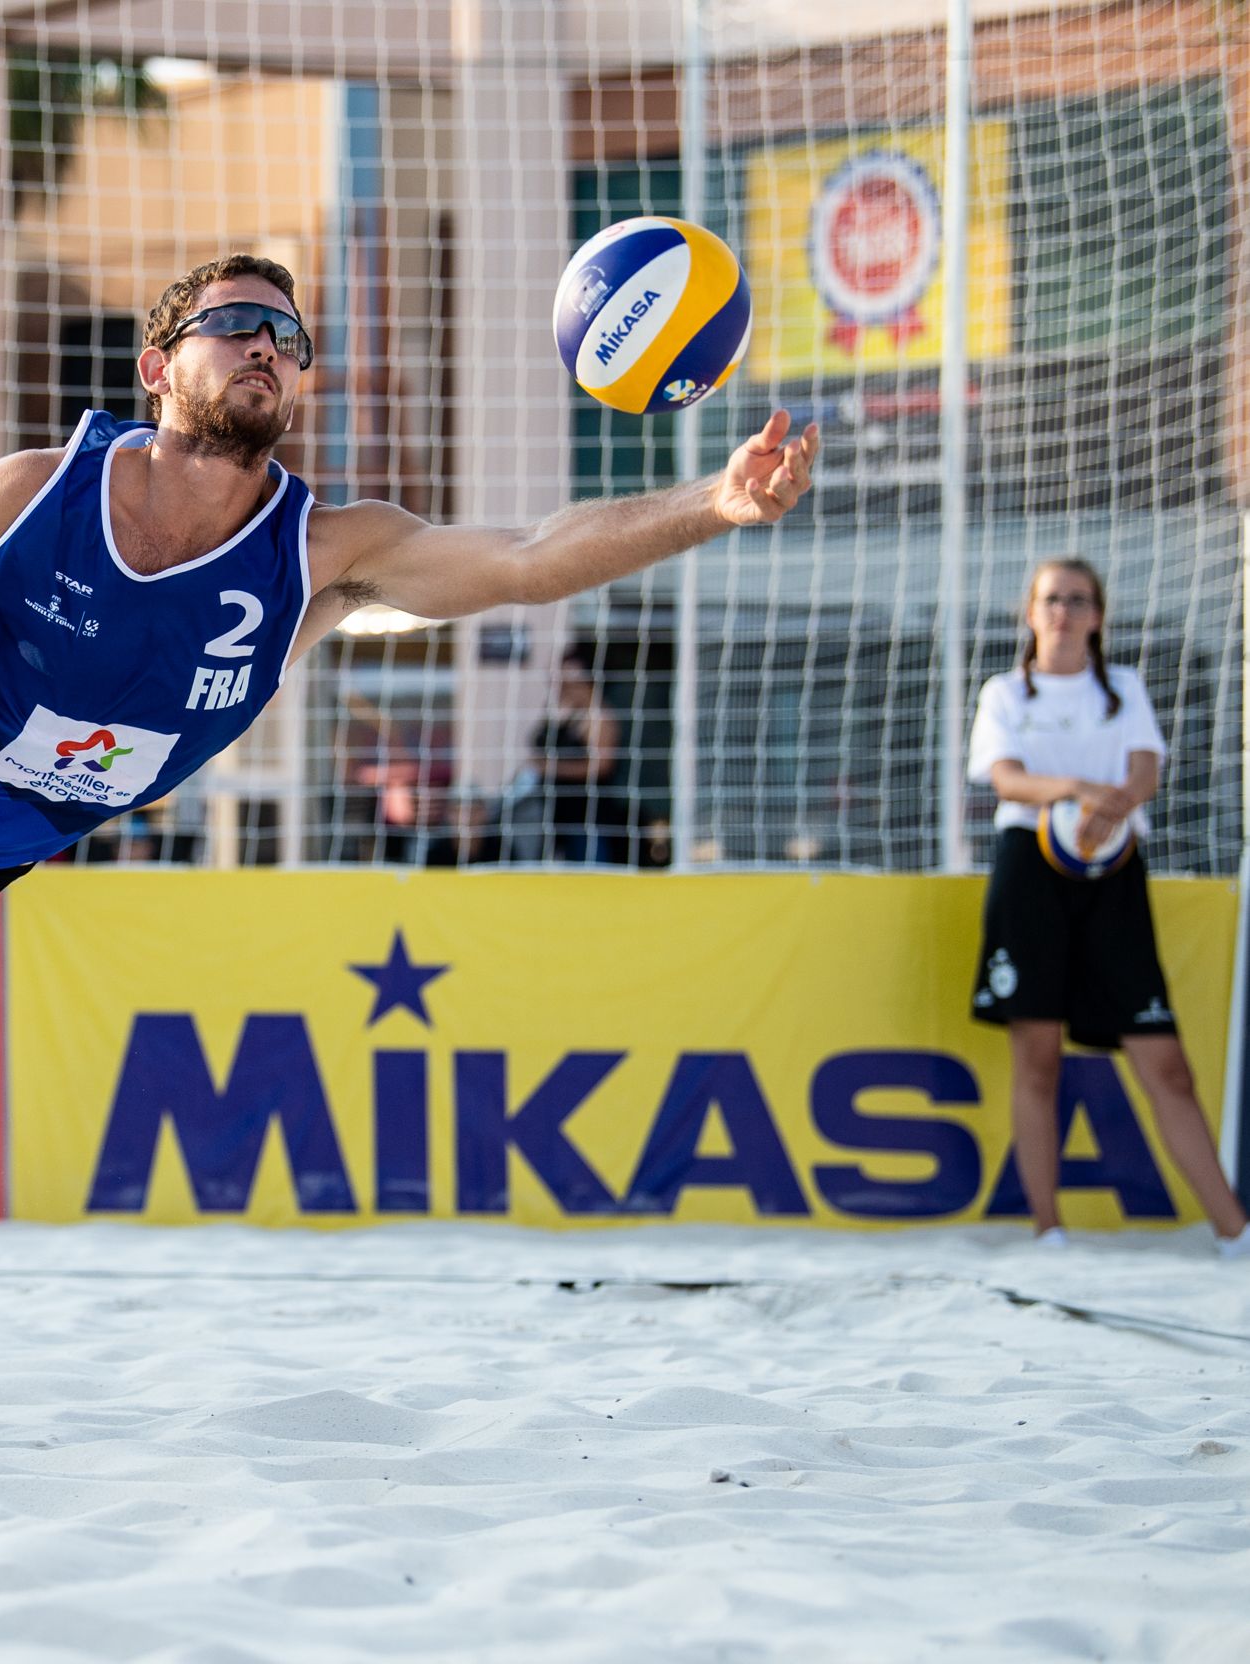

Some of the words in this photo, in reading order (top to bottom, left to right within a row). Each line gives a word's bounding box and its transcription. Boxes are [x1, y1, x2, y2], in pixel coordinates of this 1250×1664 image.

[55, 570, 93, 595] STAR
[82, 630, 97, 638] CEV
[204, 589, 264, 659] 2
[185, 663, 253, 711] FRA
